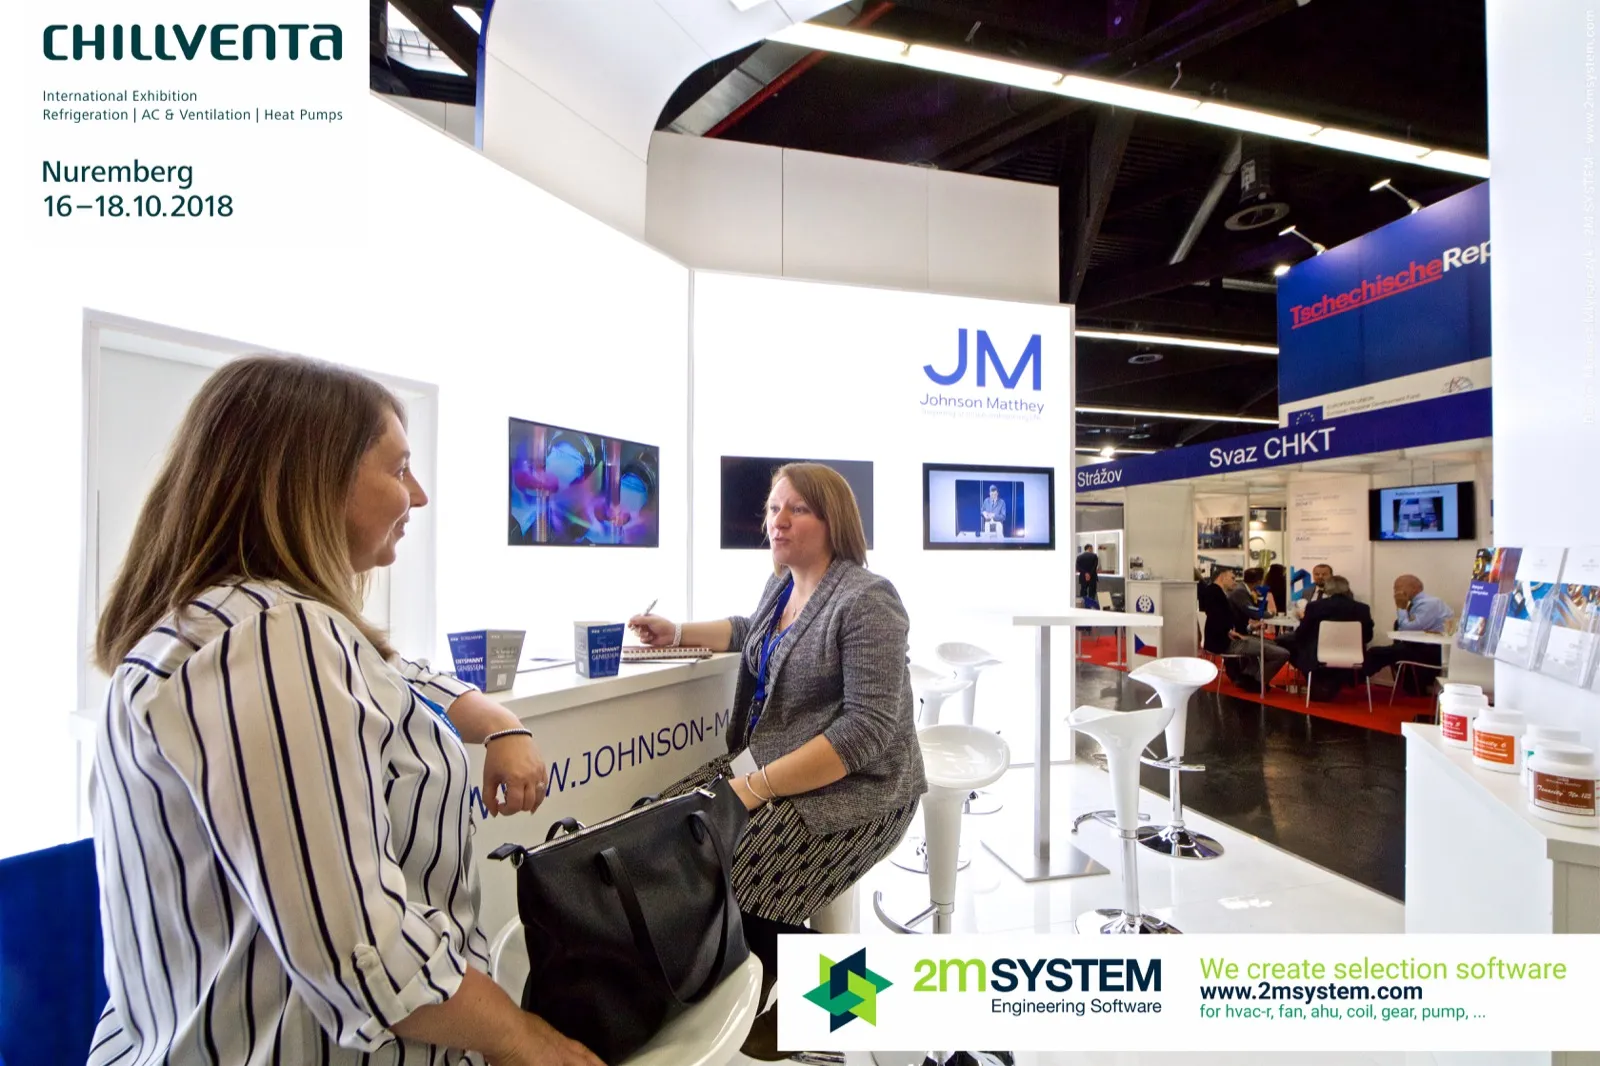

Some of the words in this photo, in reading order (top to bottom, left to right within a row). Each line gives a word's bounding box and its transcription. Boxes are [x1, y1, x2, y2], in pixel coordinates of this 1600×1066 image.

[923, 328, 1041, 391] JM
[920, 393, 983, 408] Johnson
[987, 397, 1044, 414] Matthey
[1209, 446, 1257, 468] Svaz
[1264, 427, 1336, 460] CHKT
[1077, 468, 1122, 488] Strážov
